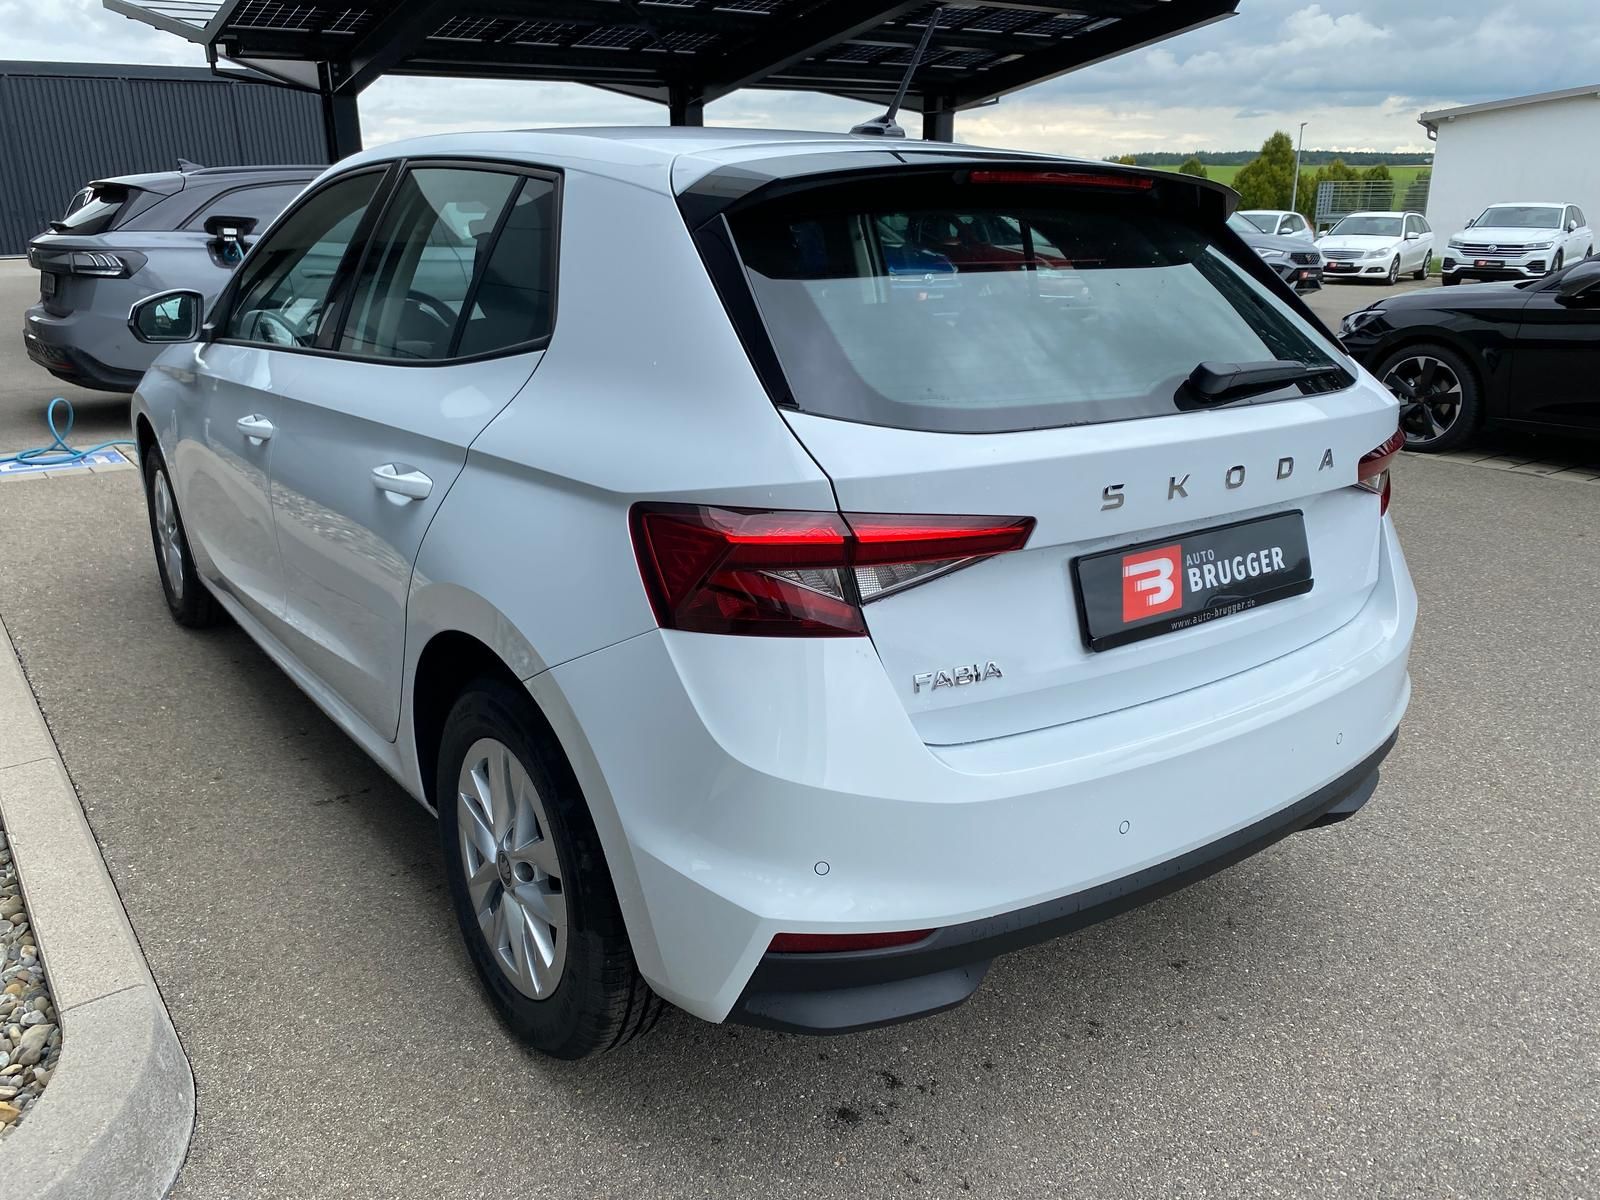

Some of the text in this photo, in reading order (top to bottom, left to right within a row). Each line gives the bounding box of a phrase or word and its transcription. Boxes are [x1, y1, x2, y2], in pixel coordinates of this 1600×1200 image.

[1100, 448, 1334, 512] SKODA
[1186, 549, 1215, 567] AUTO
[1187, 546, 1286, 593] BRUGGER
[1170, 599, 1256, 630] www.auto-brugger.de
[913, 661, 1003, 694] FABIA
